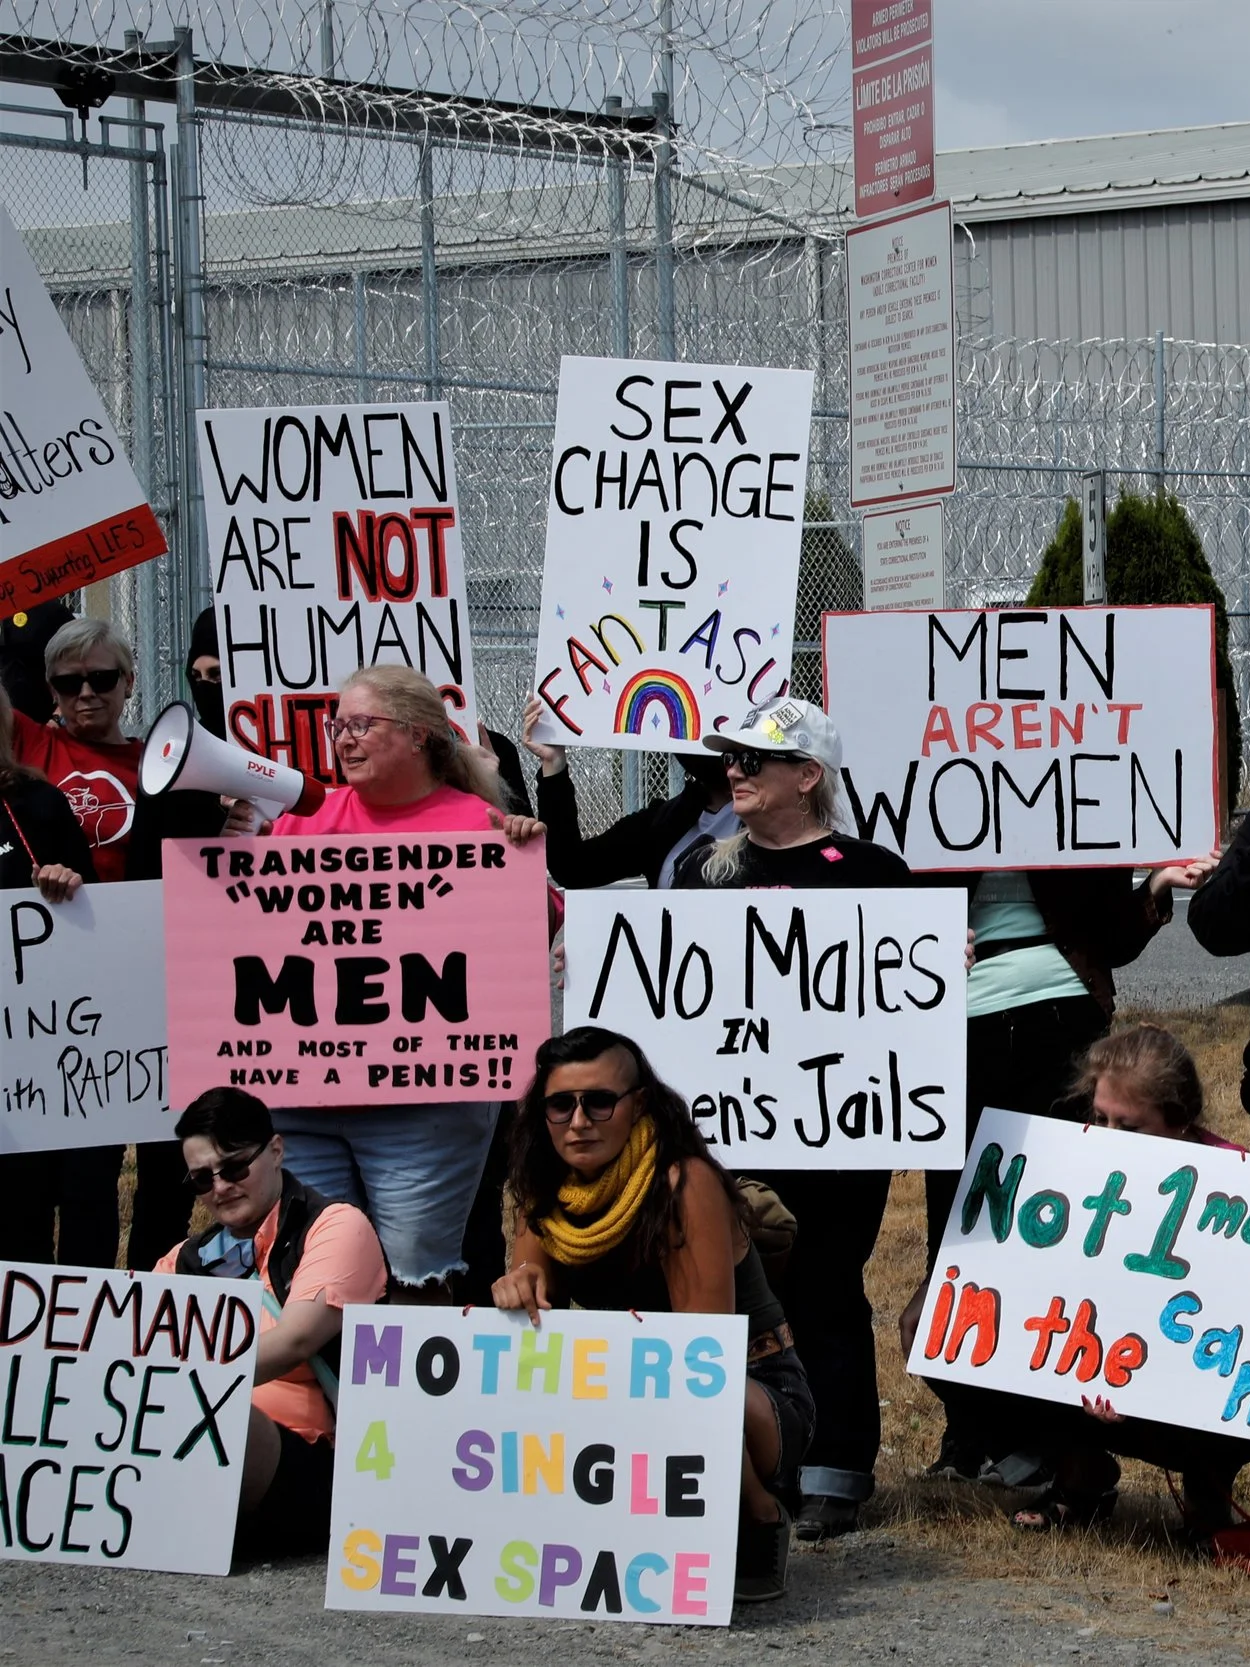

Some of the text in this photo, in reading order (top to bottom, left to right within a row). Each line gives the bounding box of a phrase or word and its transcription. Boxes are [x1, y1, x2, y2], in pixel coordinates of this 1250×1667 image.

[893, 24, 900, 41] BE
[881, 74, 892, 102] DE
[893, 72, 902, 99] LA
[903, 56, 930, 95] PRISIÓN
[609, 374, 753, 446] SEX
[204, 412, 448, 506] WOMEN
[86, 519, 146, 564] LIES
[216, 506, 456, 603] ARE NOT
[637, 518, 704, 590] IS
[224, 599, 463, 689] HUMAN
[928, 612, 1115, 702] MEN
[921, 702, 1143, 757] AREN'T
[247, 760, 276, 778] PYLE
[840, 748, 1182, 855] WOMEN
[199, 842, 507, 879] TRANSGENDER
[300, 919, 384, 946] ARE
[588, 903, 946, 1020] No Males
[232, 951, 470, 1027] MEN
[216, 1033, 519, 1058] AND MOST OF THEM
[229, 1057, 514, 1090] HAVE A PENIS!!
[716, 1017, 770, 1055] IN
[57, 1045, 169, 1119] RAPIST
[691, 1050, 947, 1148] en's Jails
[960, 1141, 1132, 1258] Not
[1123, 1164, 1199, 1280] 1
[0, 1270, 255, 1364] DEMAND
[924, 1265, 1001, 1367] in
[1023, 1295, 1148, 1388] the
[351, 1323, 727, 1400] MOTHERS
[94, 1359, 247, 1467] SEX
[355, 1420, 706, 1518] 4 SINGLE
[340, 1529, 711, 1617] SEX SPACE
